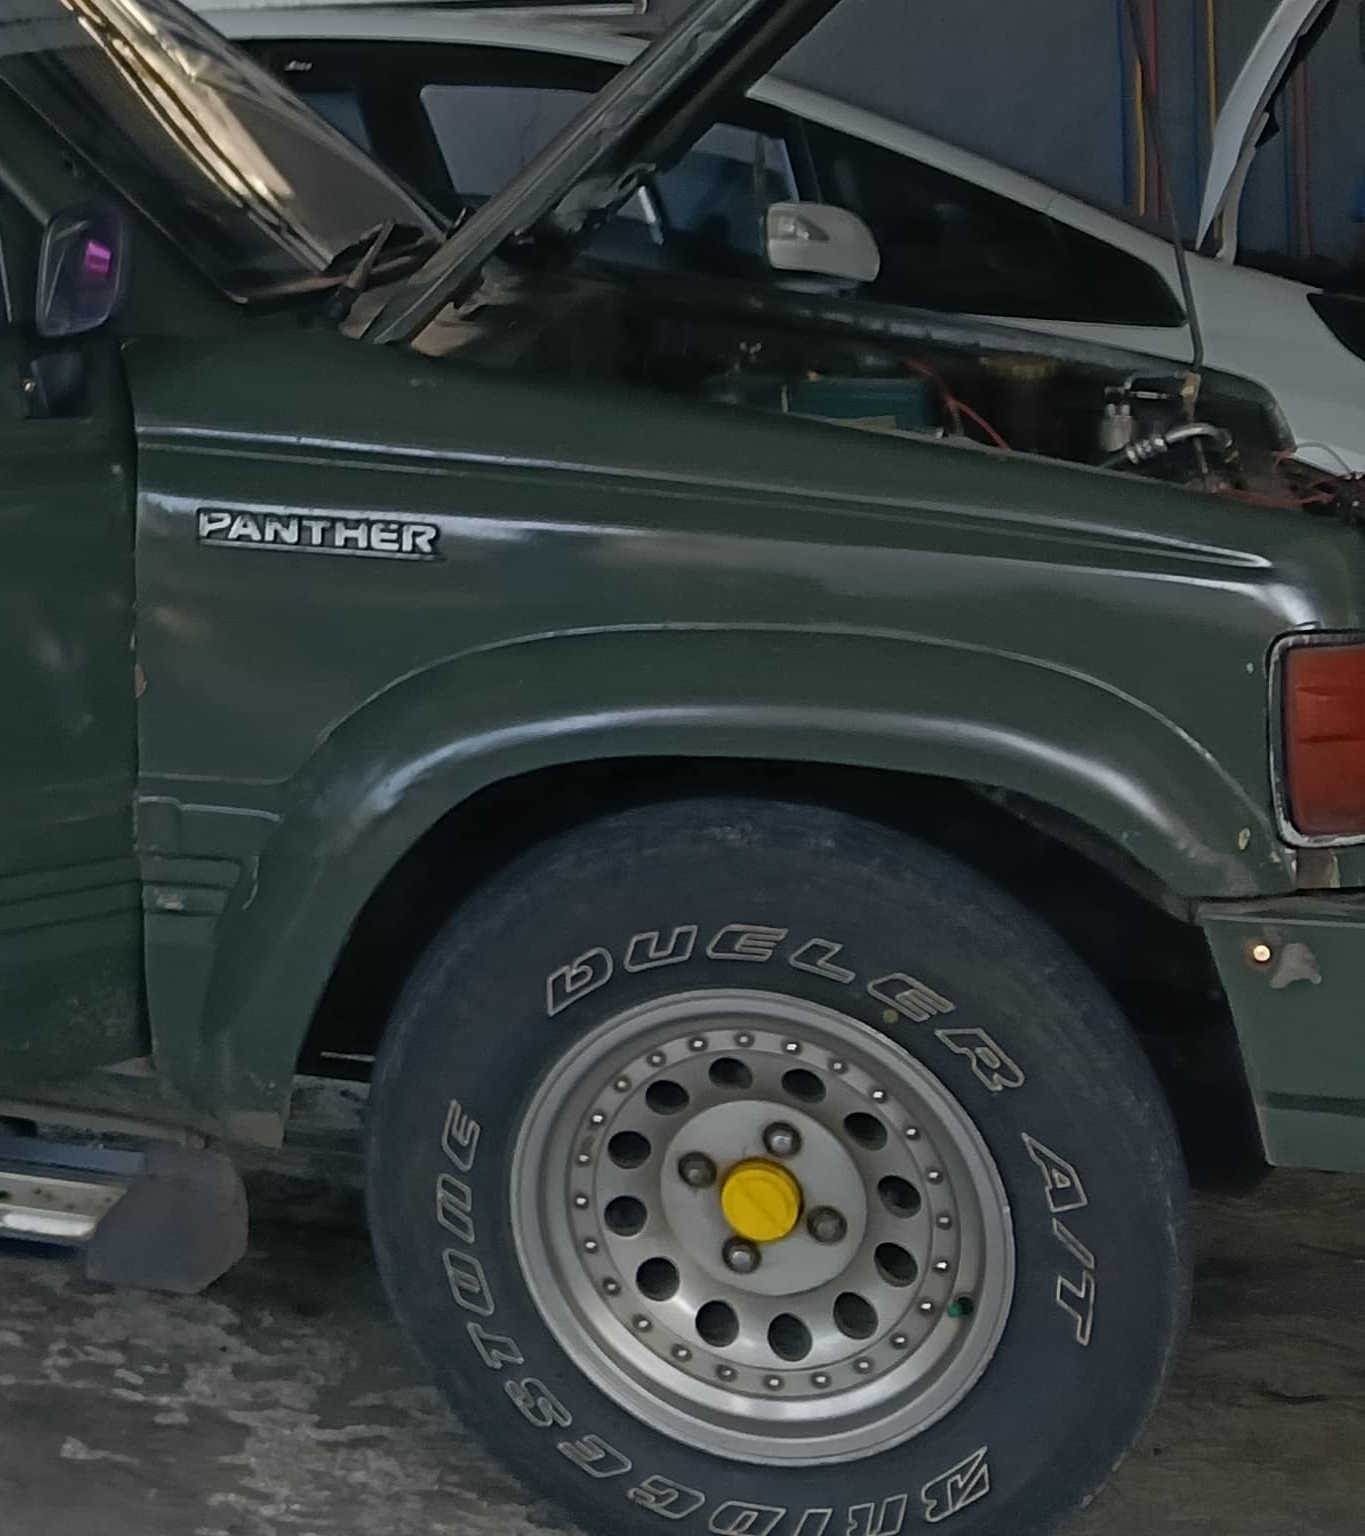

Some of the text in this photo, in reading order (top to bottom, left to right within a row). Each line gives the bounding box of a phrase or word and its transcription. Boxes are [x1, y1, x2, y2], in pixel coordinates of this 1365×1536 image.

[198, 512, 438, 553] PANTHER
[436, 1099, 995, 1536] BRIDGESTONE
[545, 923, 1097, 1346] DUELER A/T
